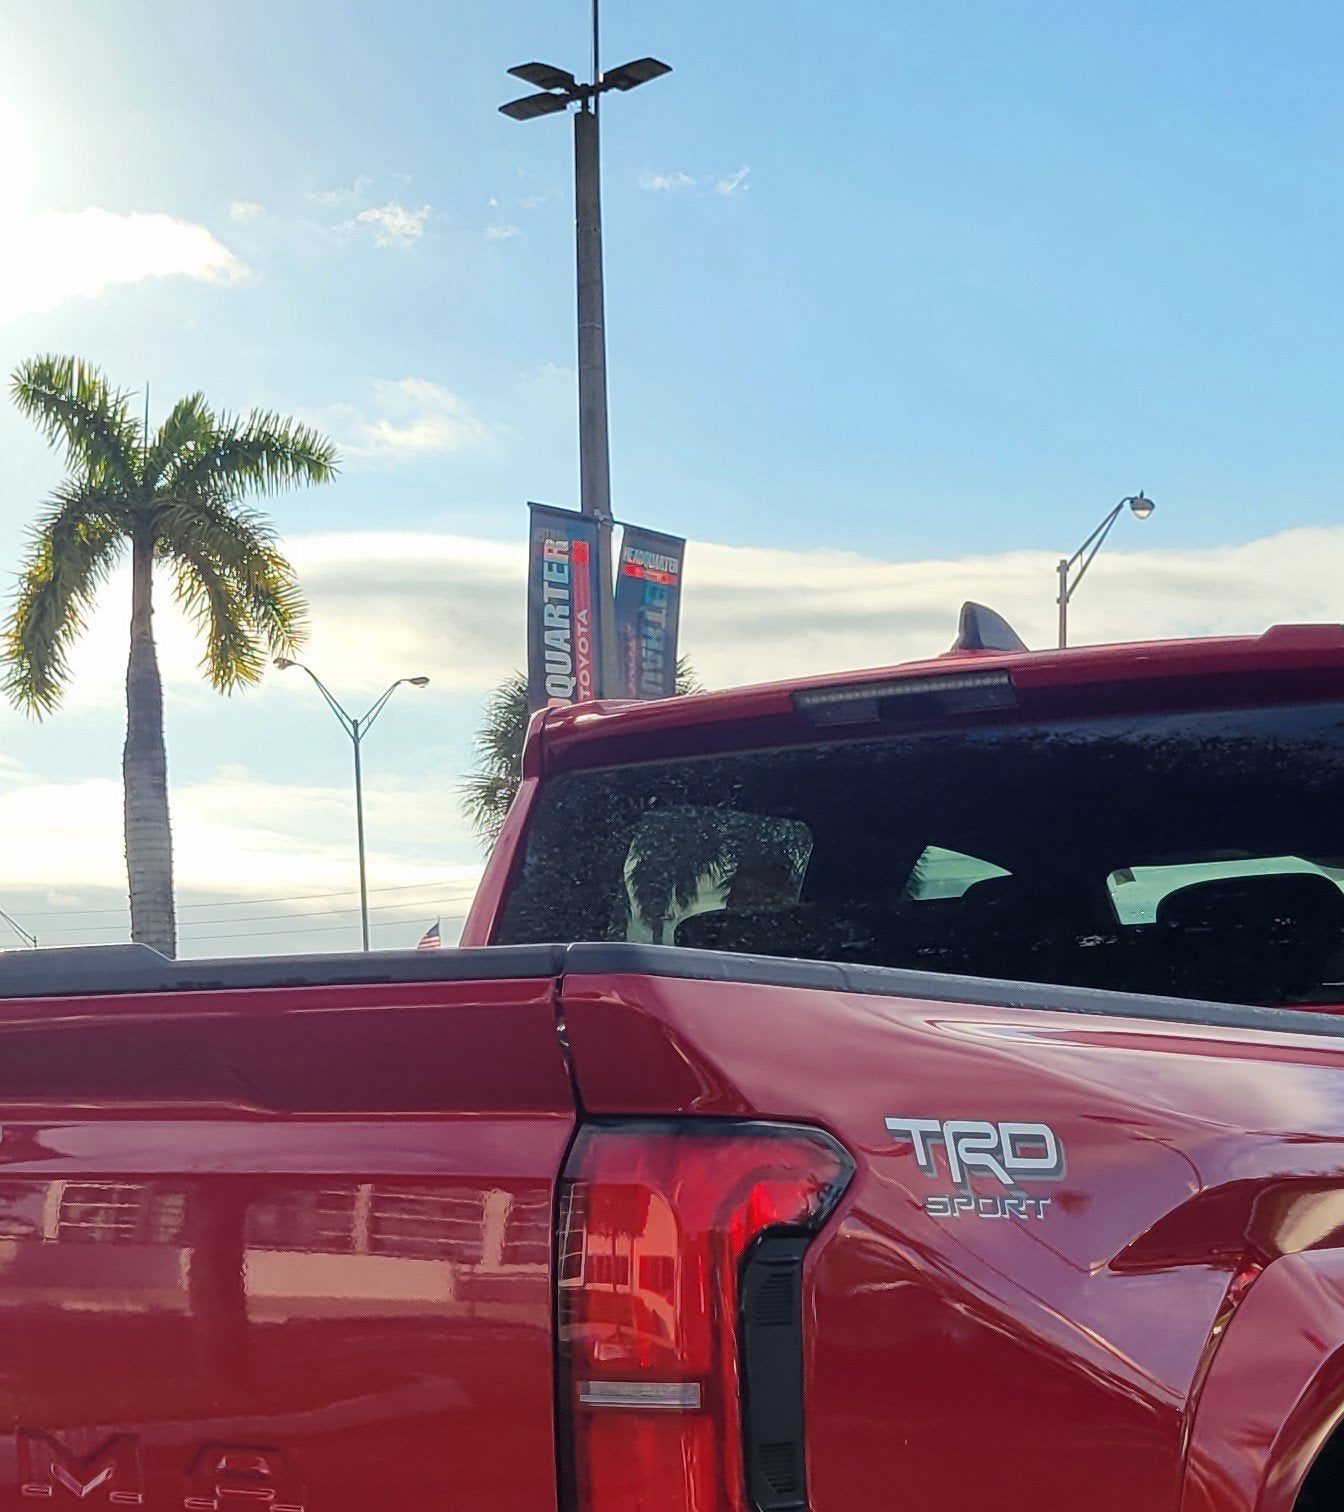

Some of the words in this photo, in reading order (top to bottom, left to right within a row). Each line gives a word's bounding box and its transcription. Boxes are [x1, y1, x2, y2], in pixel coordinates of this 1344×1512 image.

[542, 538, 576, 706] QUARTER
[577, 609, 592, 700] TOYOTA
[884, 1116, 1060, 1184] TRD
[924, 1197, 1051, 1220] SPORT
